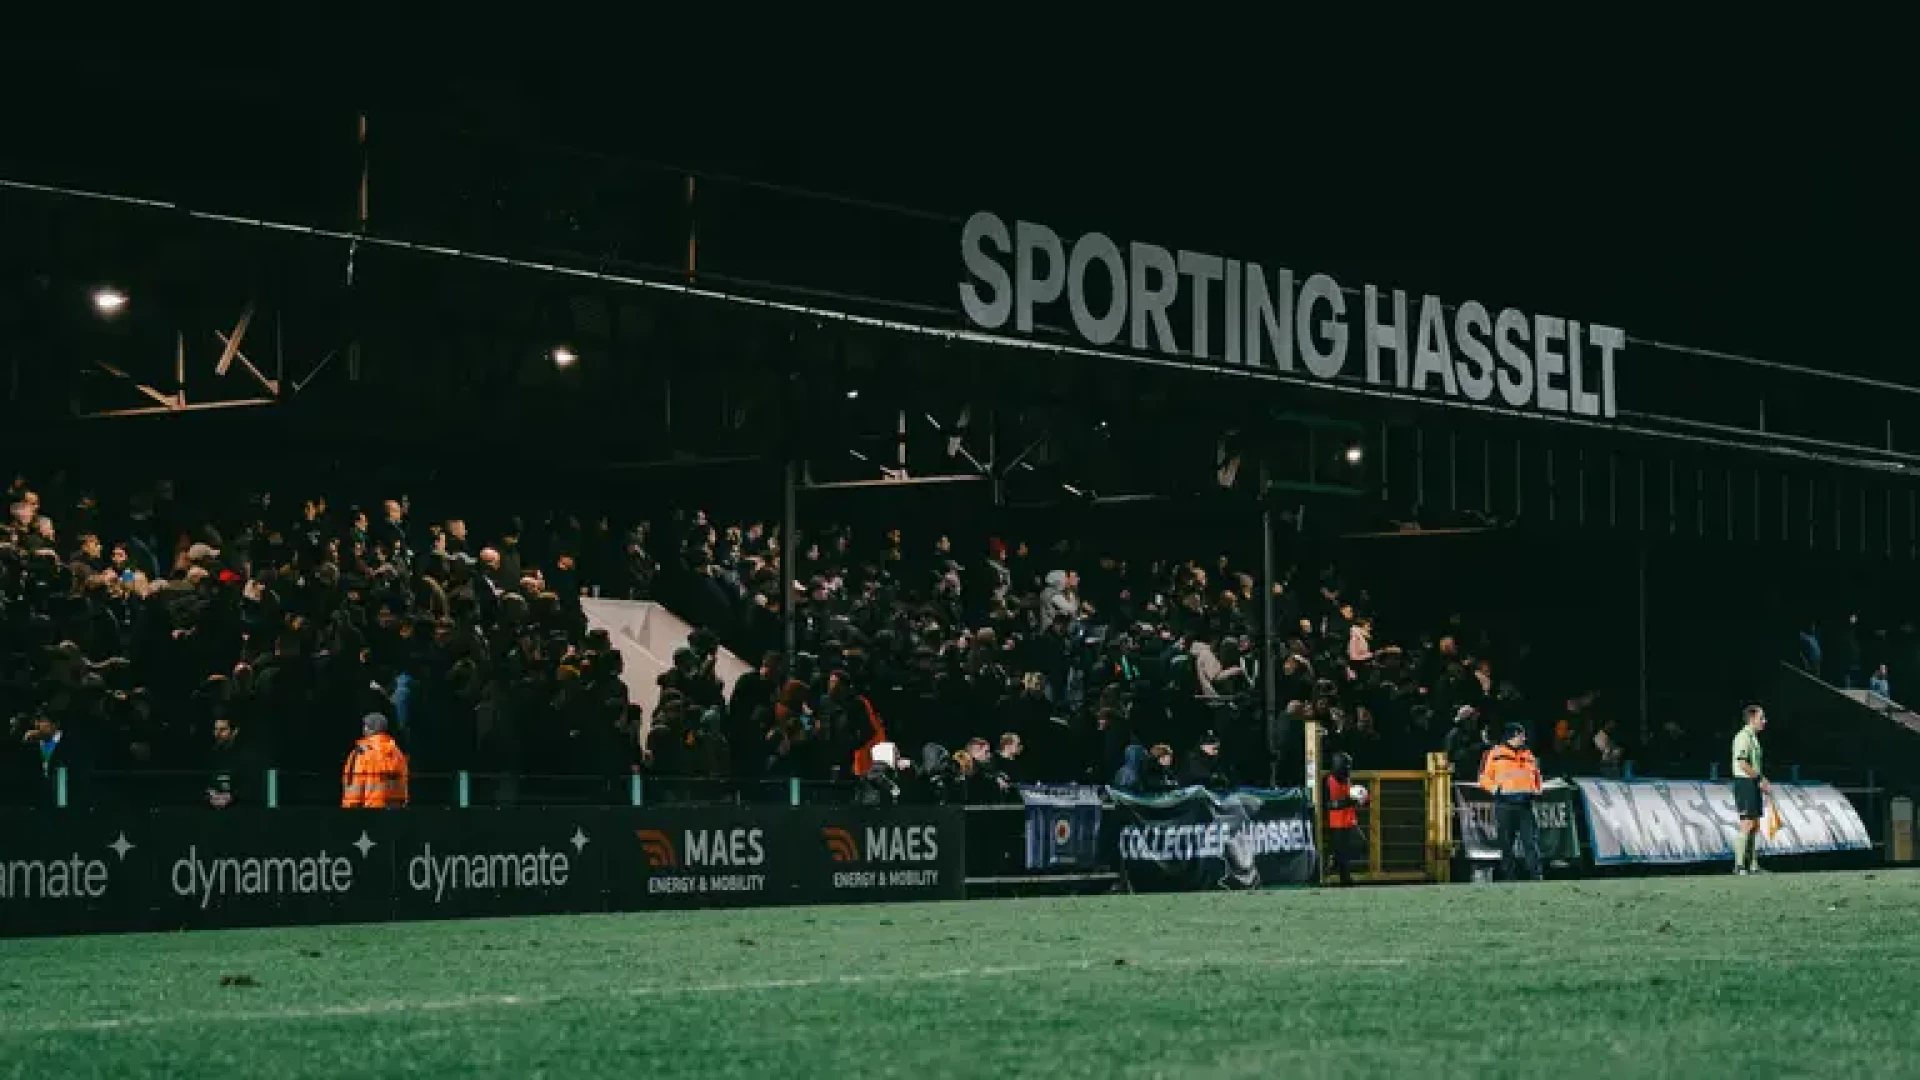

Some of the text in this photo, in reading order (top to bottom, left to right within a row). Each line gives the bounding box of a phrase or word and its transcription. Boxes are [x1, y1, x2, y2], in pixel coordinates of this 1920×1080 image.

[959, 212, 1625, 418] SPORTING HASSELT
[685, 828, 764, 866] MAES
[866, 825, 938, 862] MAES
[0, 852, 108, 898] mate
[172, 844, 353, 908] dynamate
[410, 842, 569, 903] dynamate
[648, 876, 696, 894] ENERGY
[710, 874, 765, 891] MOBILITY
[833, 871, 876, 888] ENERGY
[889, 869, 939, 886] MOBILITY
